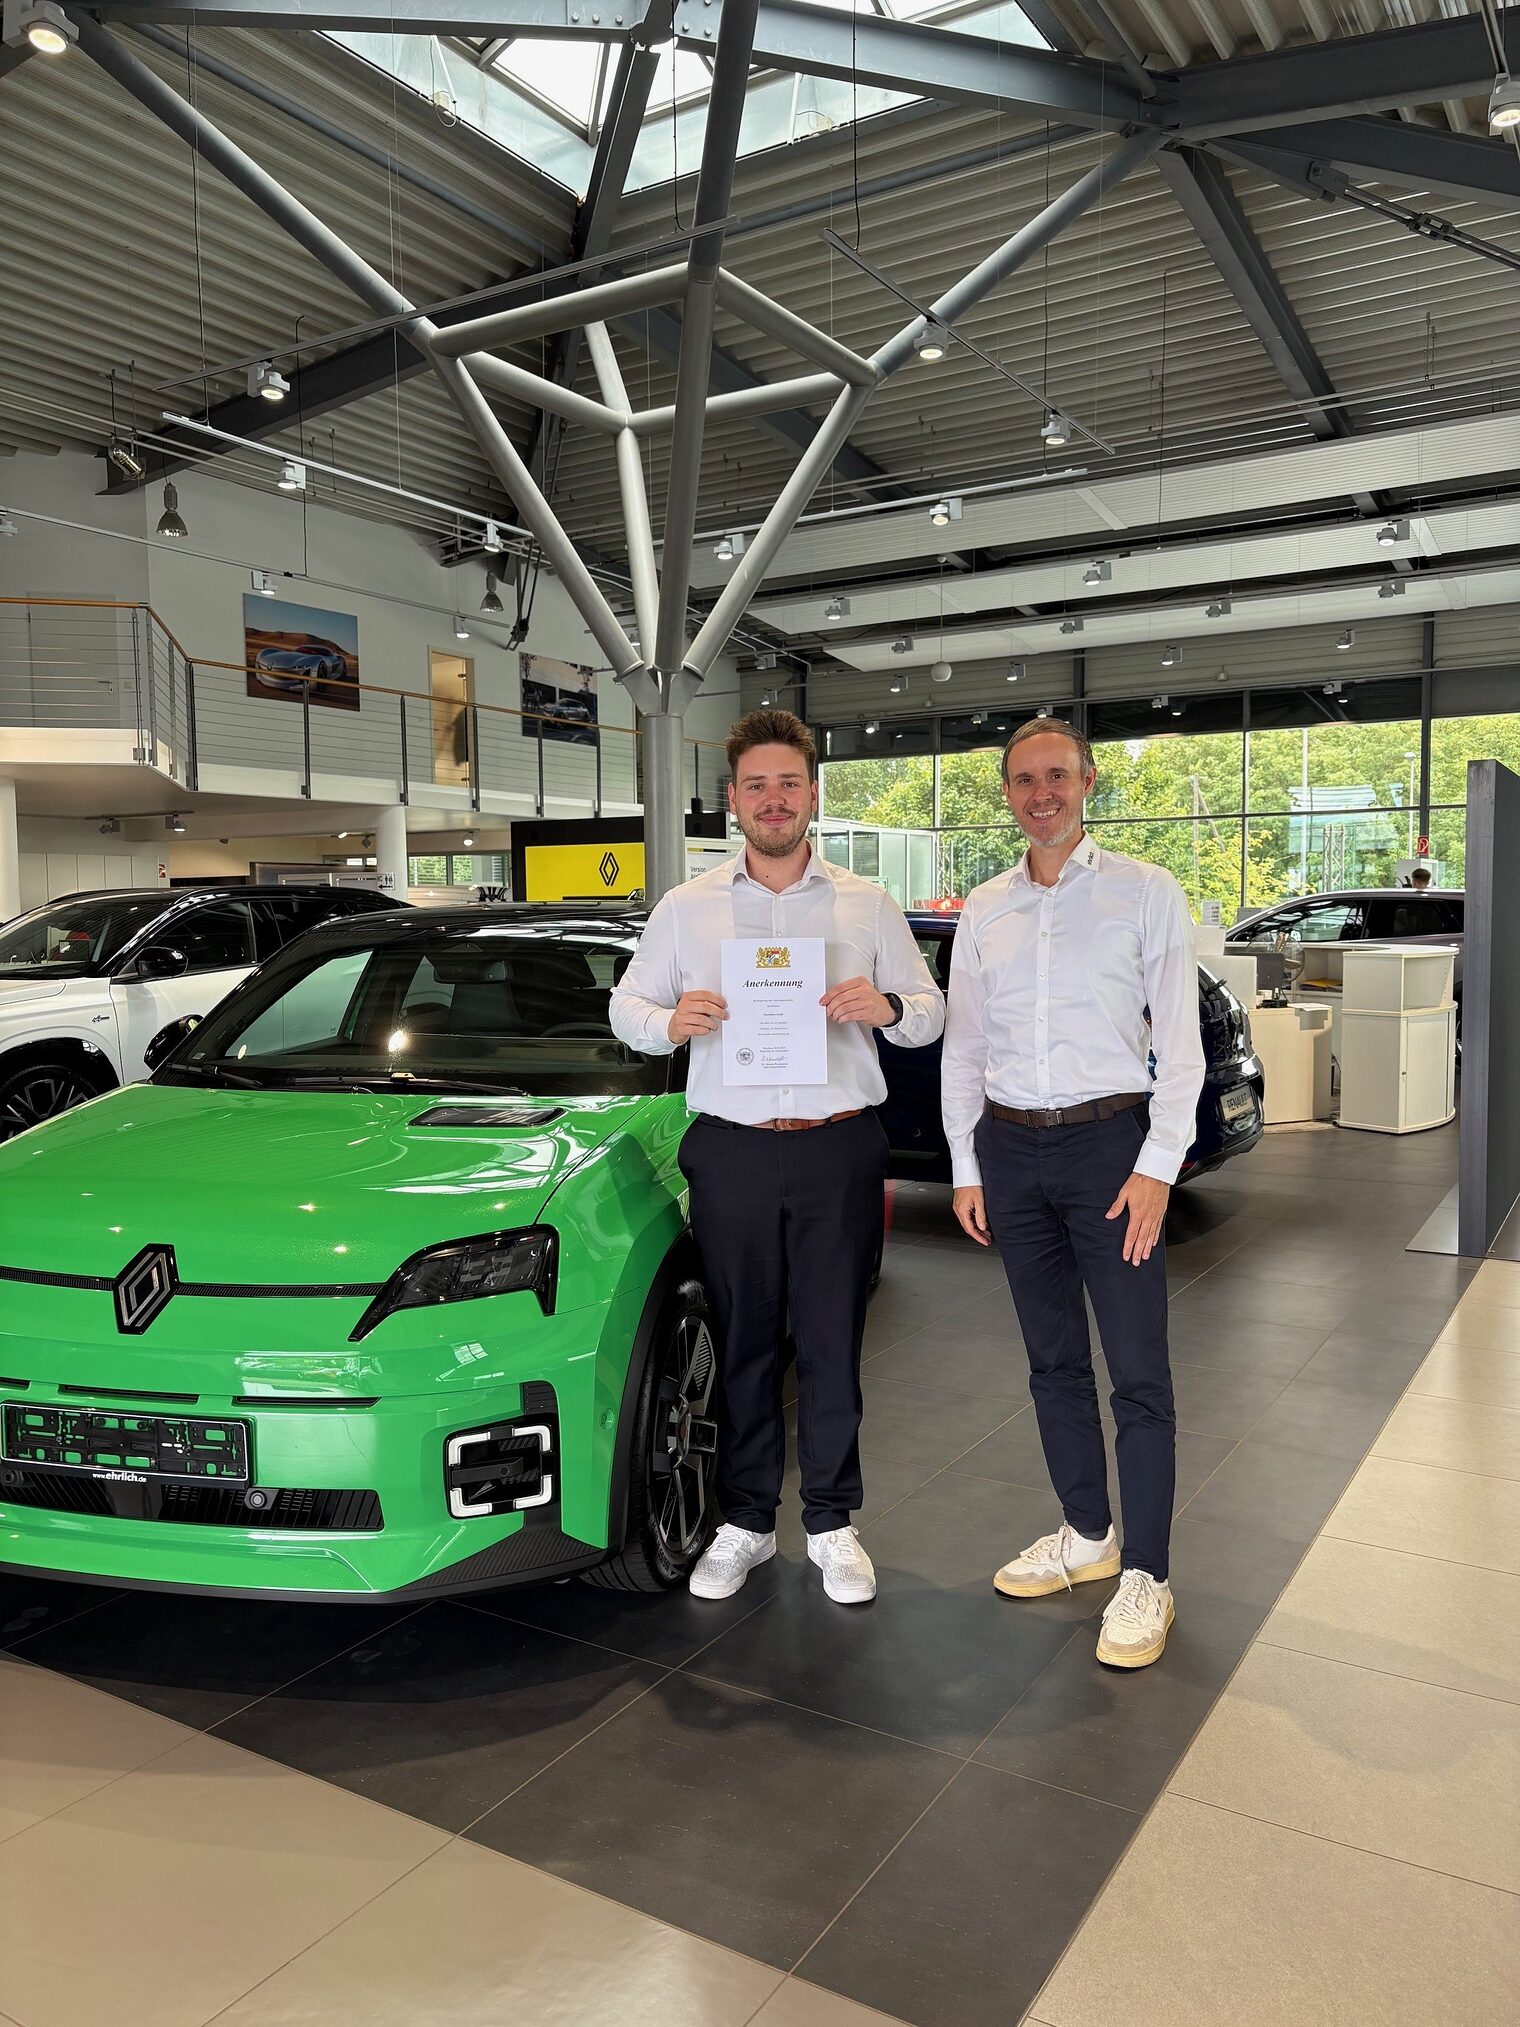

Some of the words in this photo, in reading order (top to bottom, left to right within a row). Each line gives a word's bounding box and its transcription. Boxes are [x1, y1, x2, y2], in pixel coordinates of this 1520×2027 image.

[690, 865, 707, 873] Version
[742, 978, 803, 989] Anerkennung
[1226, 1092, 1248, 1112] RENAULT
[92, 1471, 147, 1483] www.ehrlich.de
